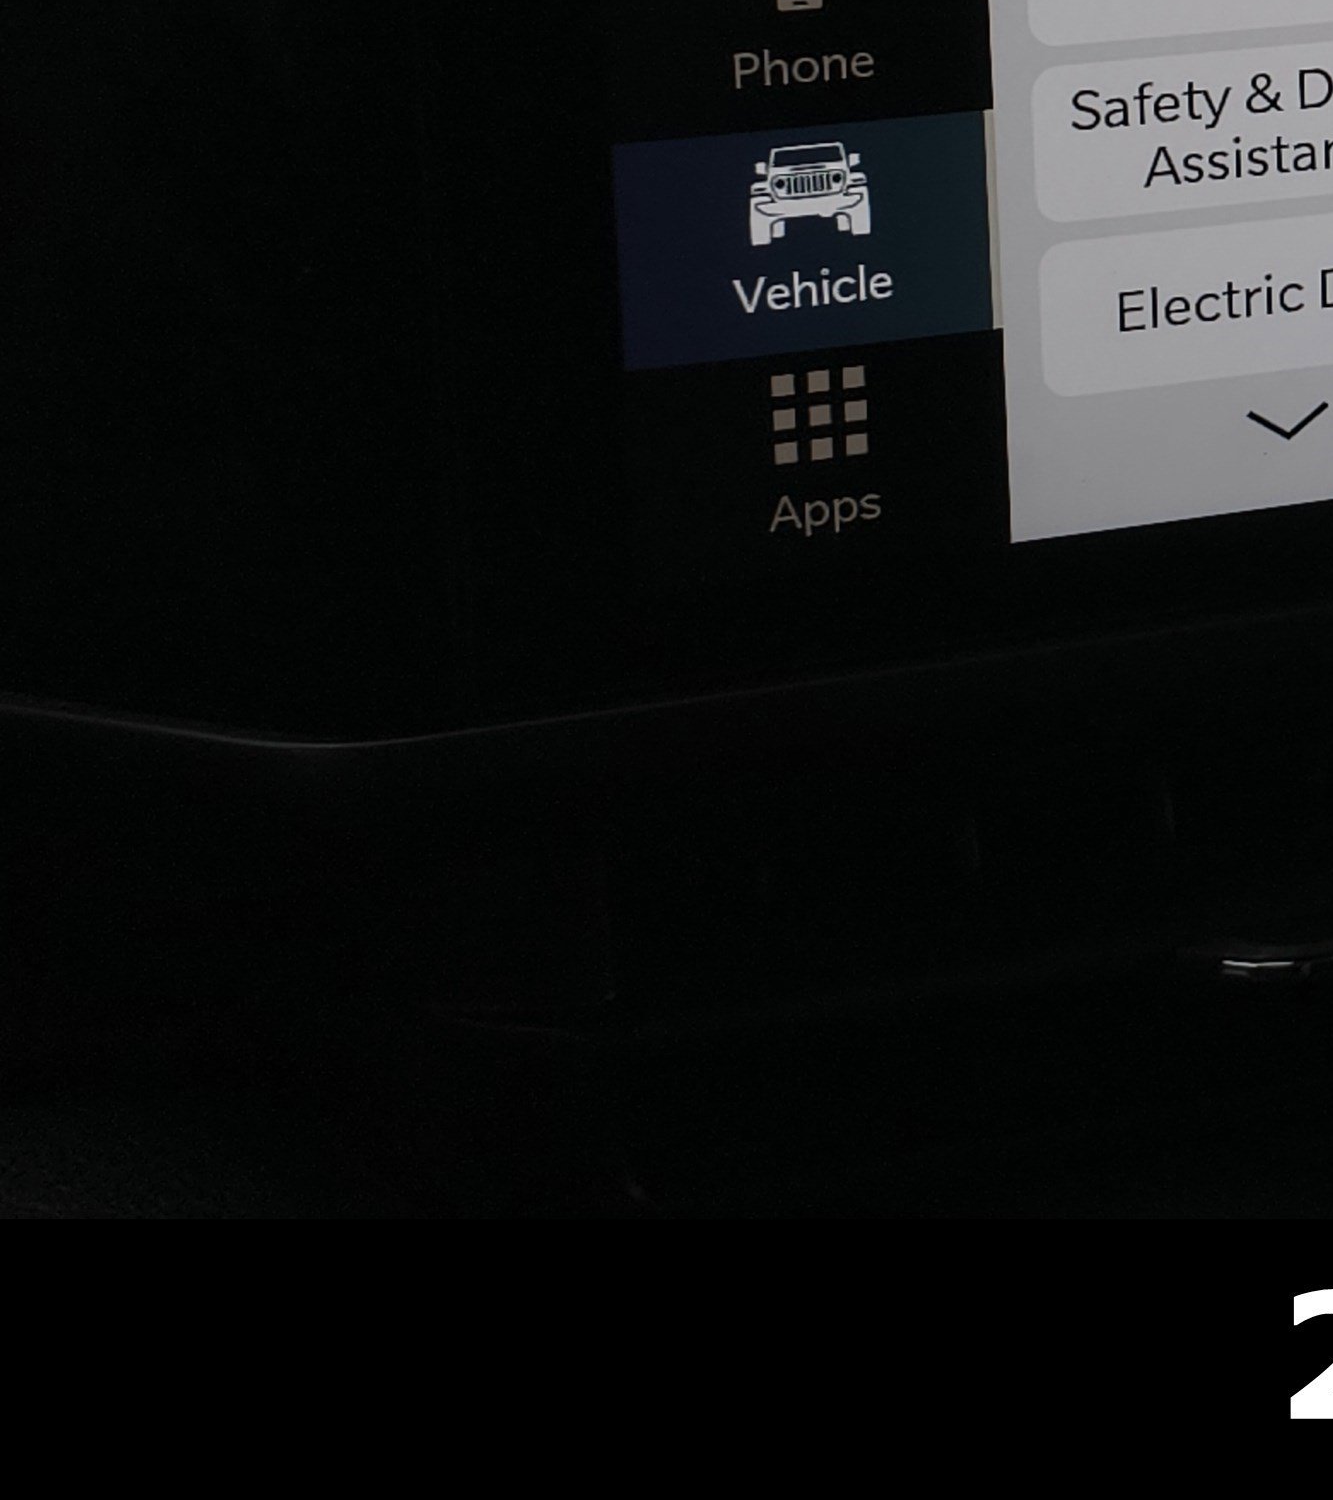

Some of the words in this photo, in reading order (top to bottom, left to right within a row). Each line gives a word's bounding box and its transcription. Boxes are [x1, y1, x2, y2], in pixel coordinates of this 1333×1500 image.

[733, 48, 874, 90] Phone
[1071, 81, 1232, 131] Safety
[1245, 72, 1284, 114] &
[732, 264, 893, 314] Vehicle
[1118, 283, 1305, 332] Electric
[769, 493, 882, 537] Apps
